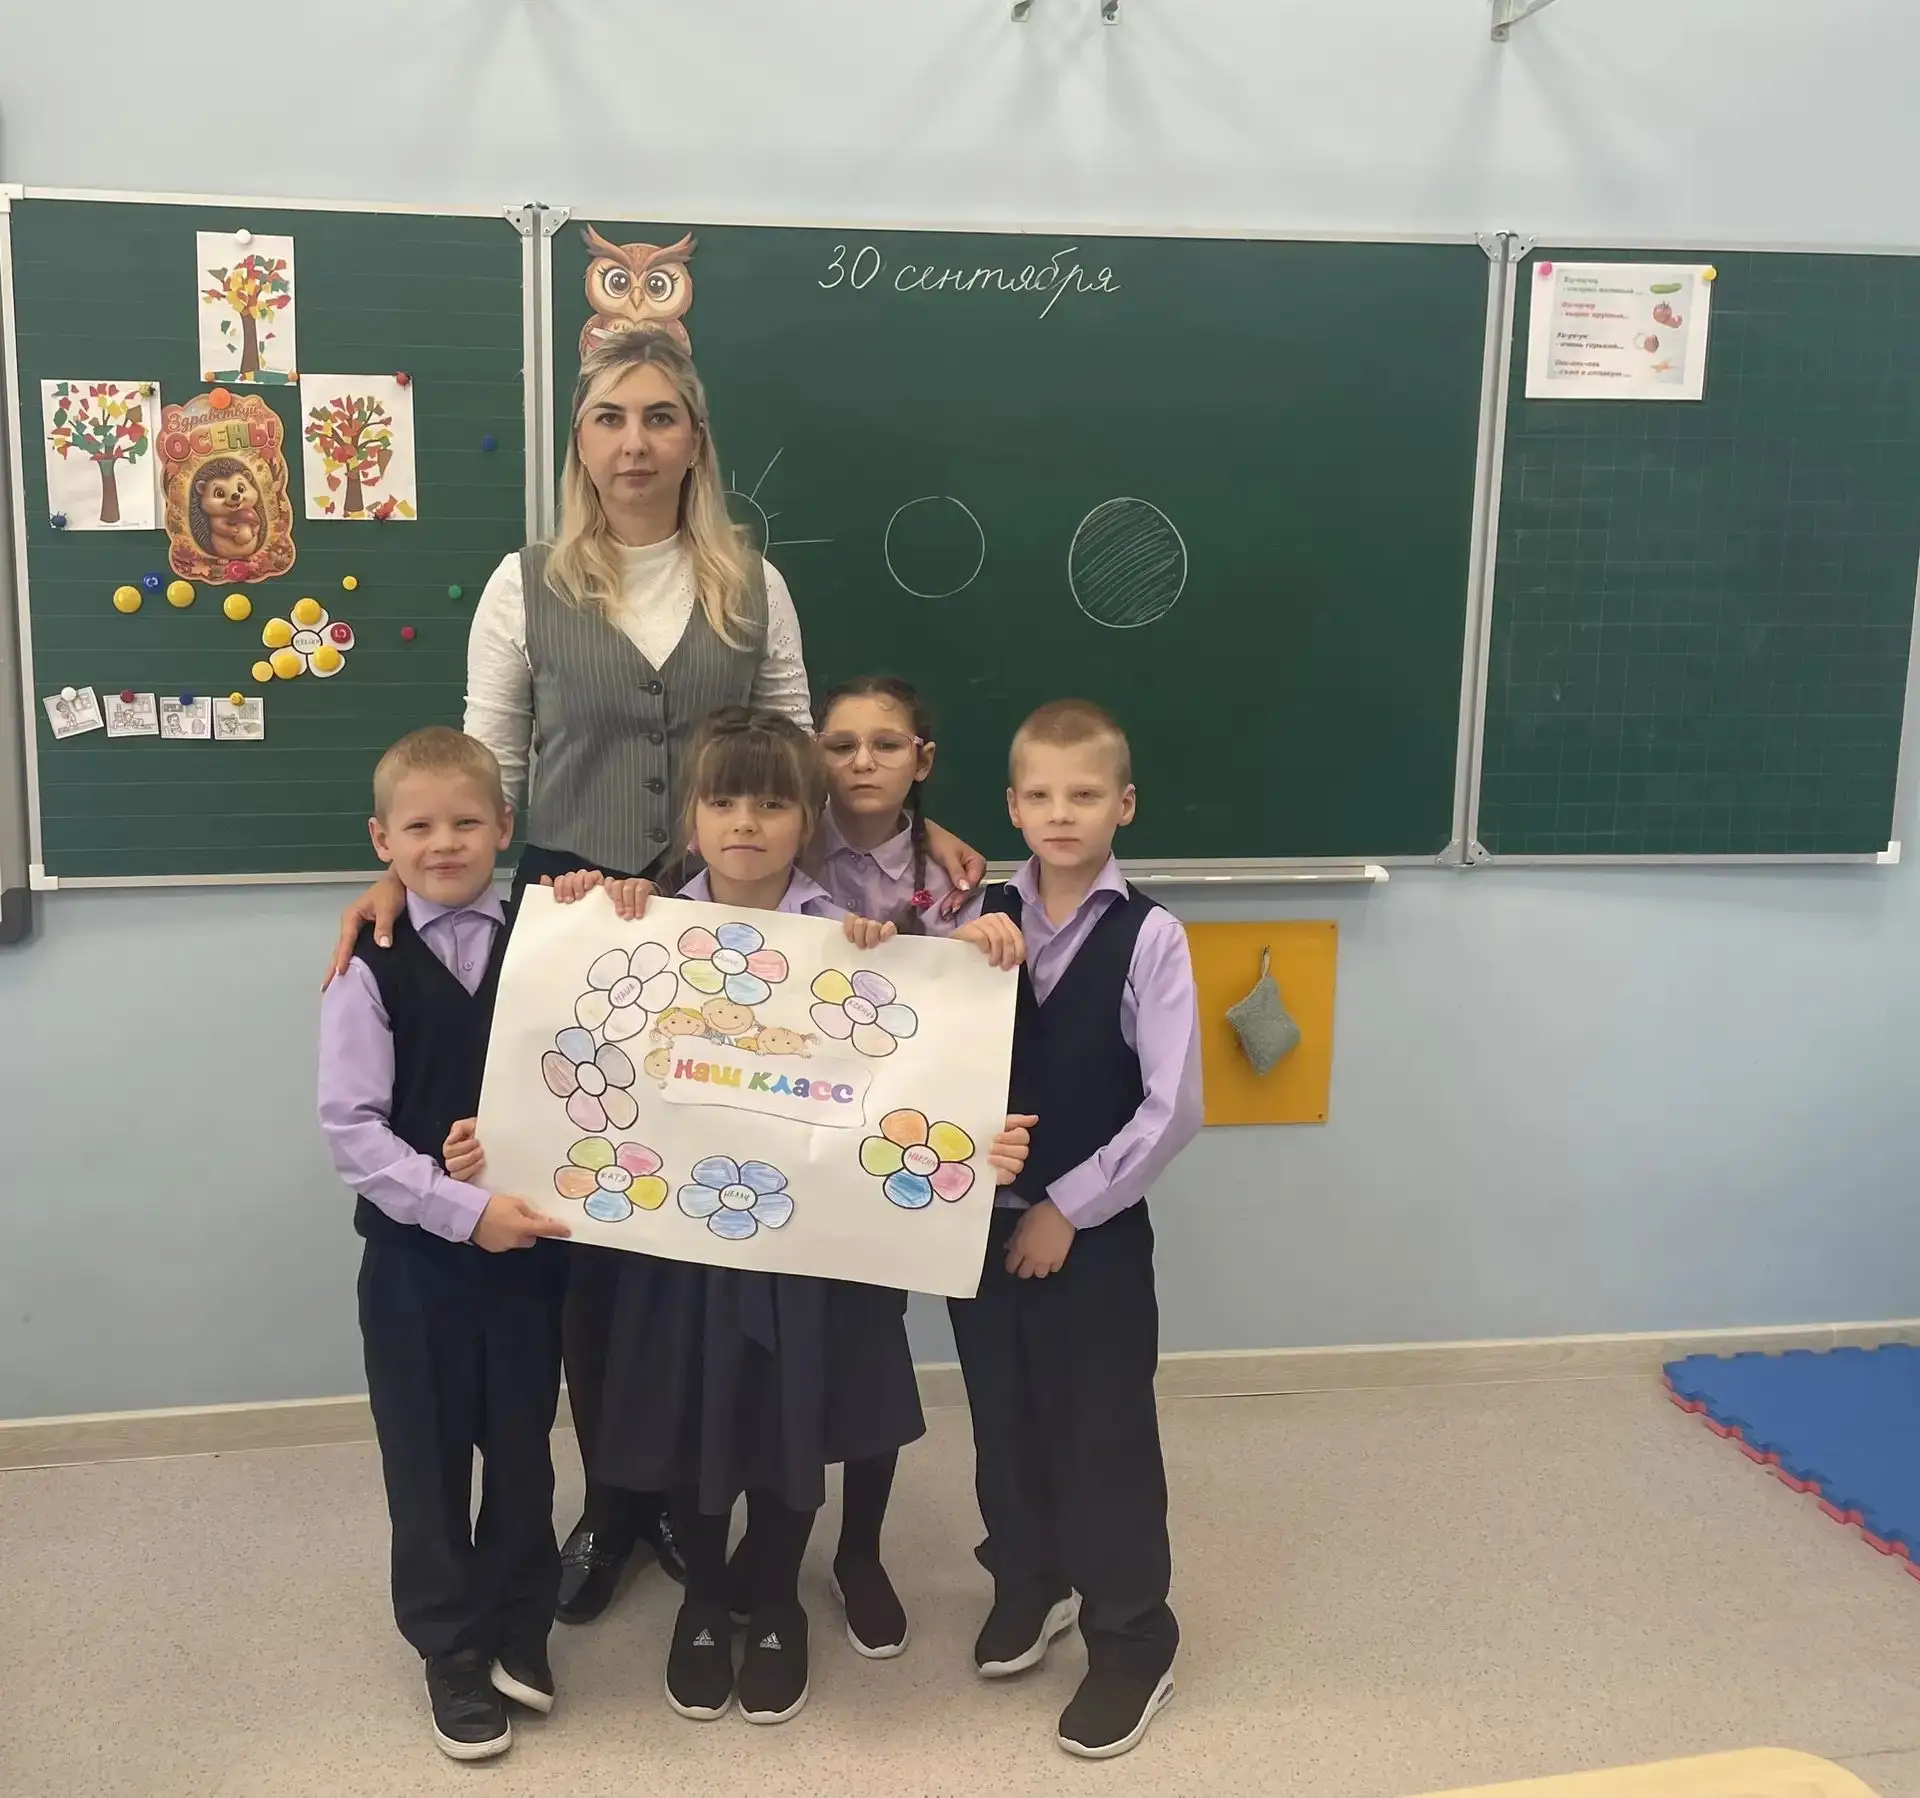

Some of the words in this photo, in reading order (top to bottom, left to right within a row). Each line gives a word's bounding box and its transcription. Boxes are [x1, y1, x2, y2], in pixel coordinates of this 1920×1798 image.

[818, 244, 881, 290] 30
[894, 246, 1122, 319] сентября
[164, 420, 277, 461] ОСЕНЬ!
